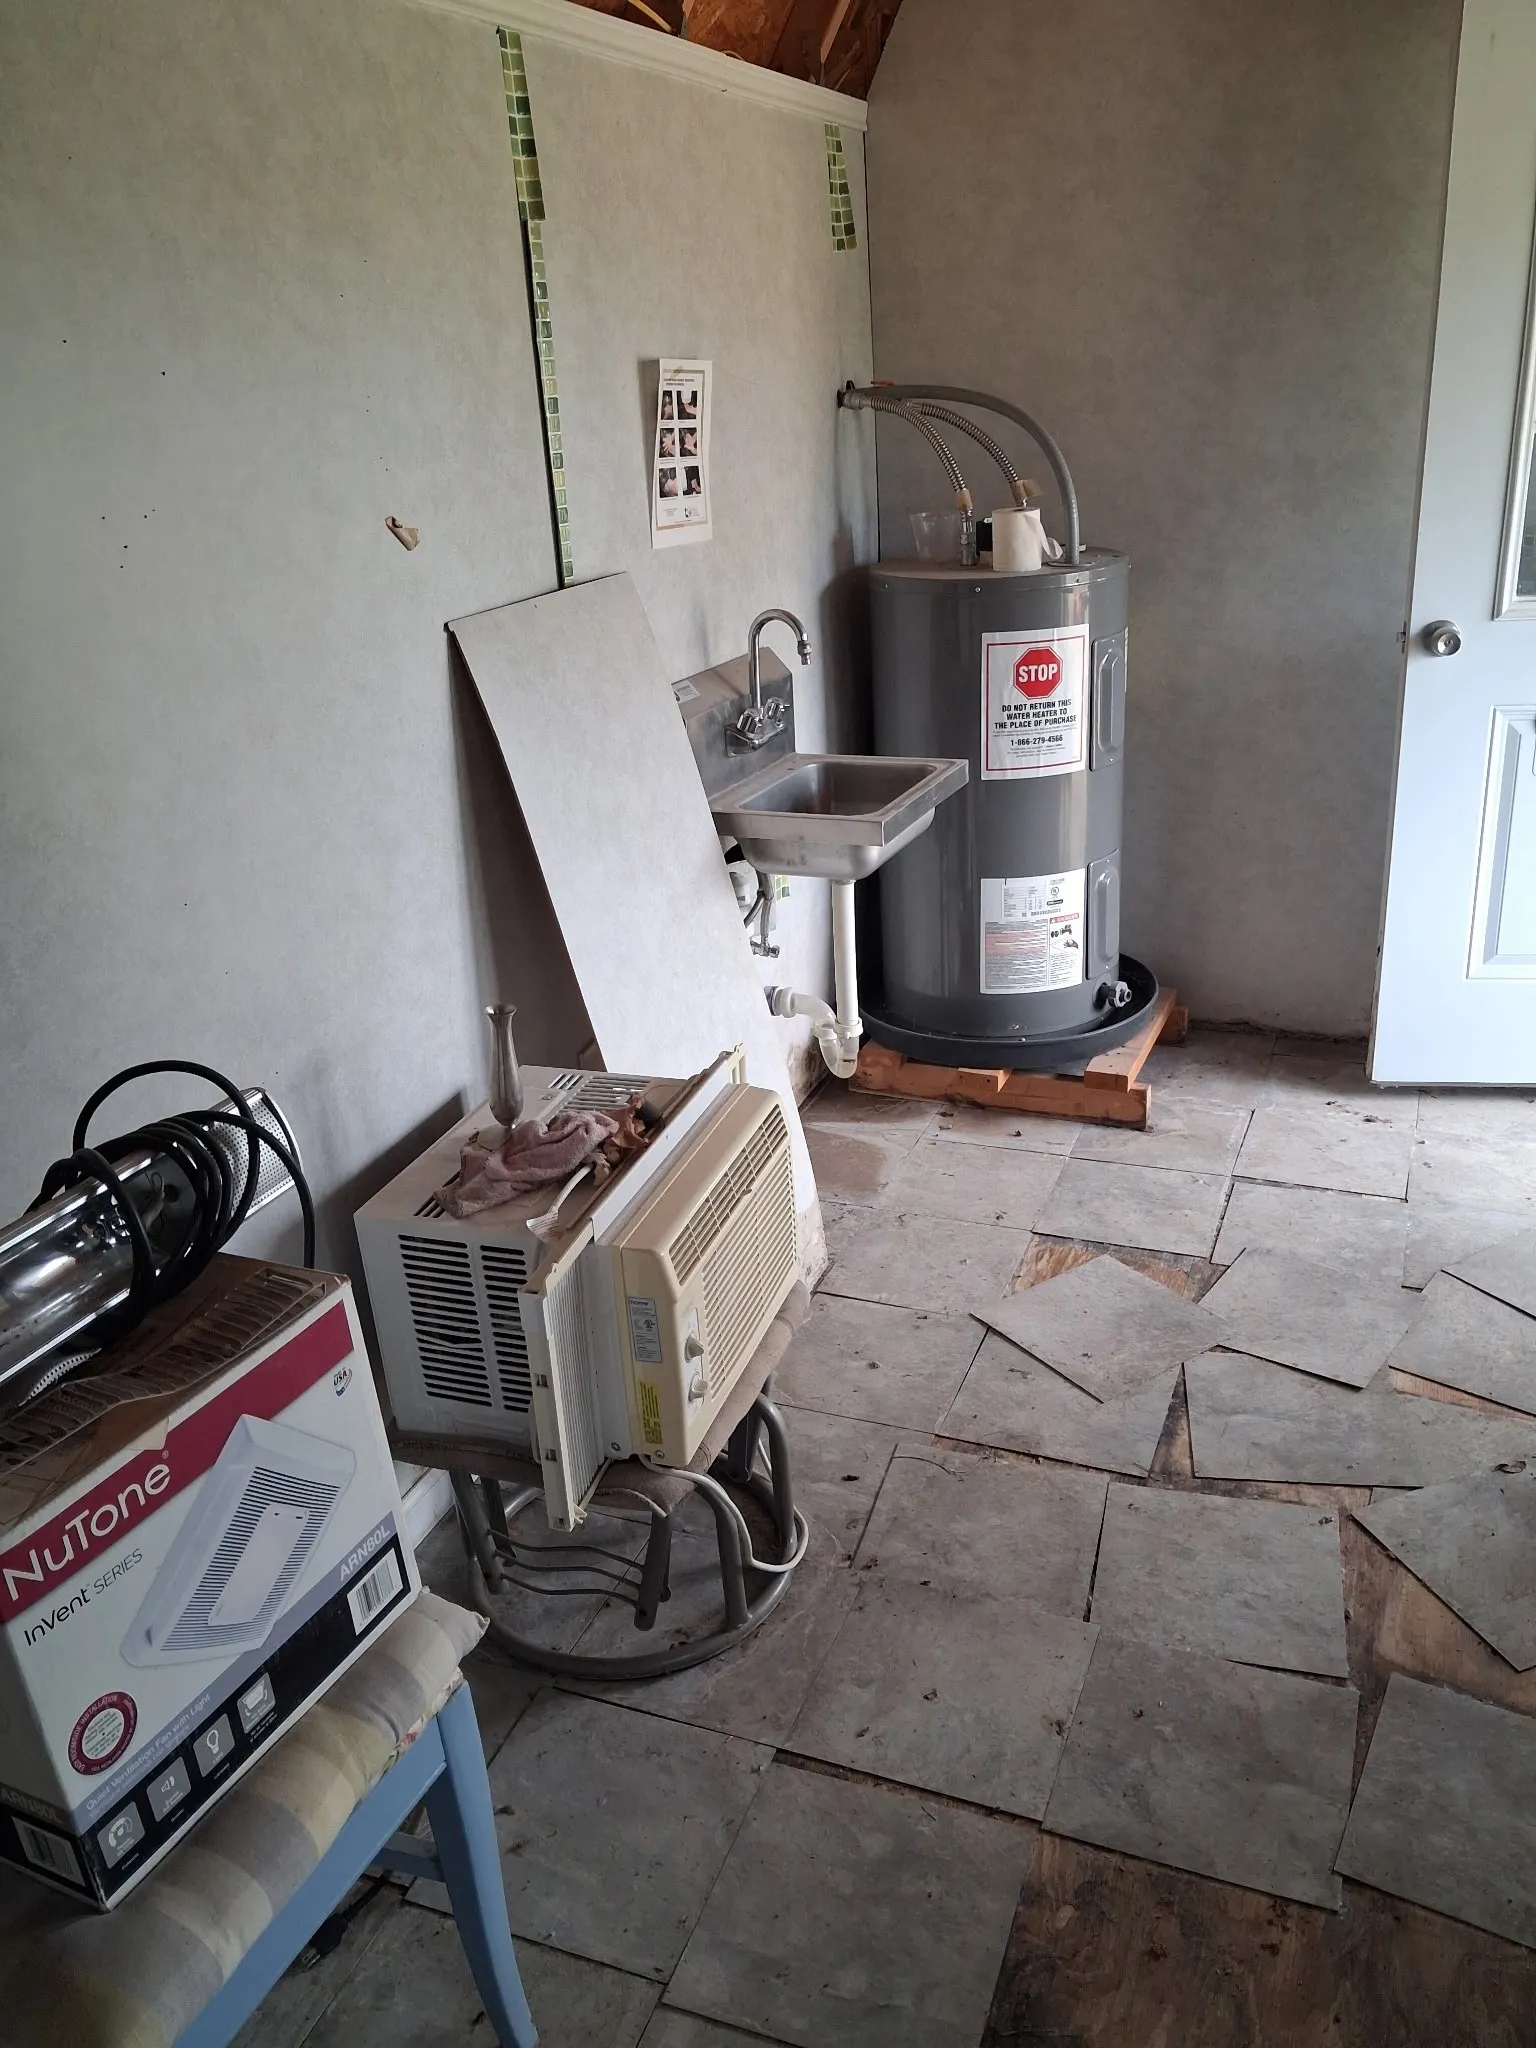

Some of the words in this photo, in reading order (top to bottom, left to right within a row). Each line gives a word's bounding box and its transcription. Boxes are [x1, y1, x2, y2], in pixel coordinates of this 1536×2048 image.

[1018, 663, 1058, 683] STOP
[994, 721, 1008, 730] THE
[1009, 719, 1032, 729] PLACE
[1034, 718, 1043, 727] OF
[1044, 714, 1077, 726] PURCHASE
[1002, 705, 1012, 713] DO
[1014, 703, 1027, 712] NOT
[1029, 701, 1056, 711] RETURN
[1057, 698, 1072, 708] THIS
[1006, 711, 1031, 721] WATER
[1032, 709, 1058, 719] HEATER
[1059, 707, 1068, 716] TO
[2, 1463, 171, 1601] NuTone
[340, 1525, 391, 1581] ARN80L
[23, 1588, 91, 1647] InVent
[93, 1548, 143, 1595] SERIES
[80, 1693, 119, 1726] INSTALLATION
[86, 1786, 111, 1810] Quiet
[110, 1747, 156, 1788] Ventilation
[155, 1731, 172, 1748] Fan
[172, 1714, 190, 1733] with
[190, 1694, 211, 1717] Light
